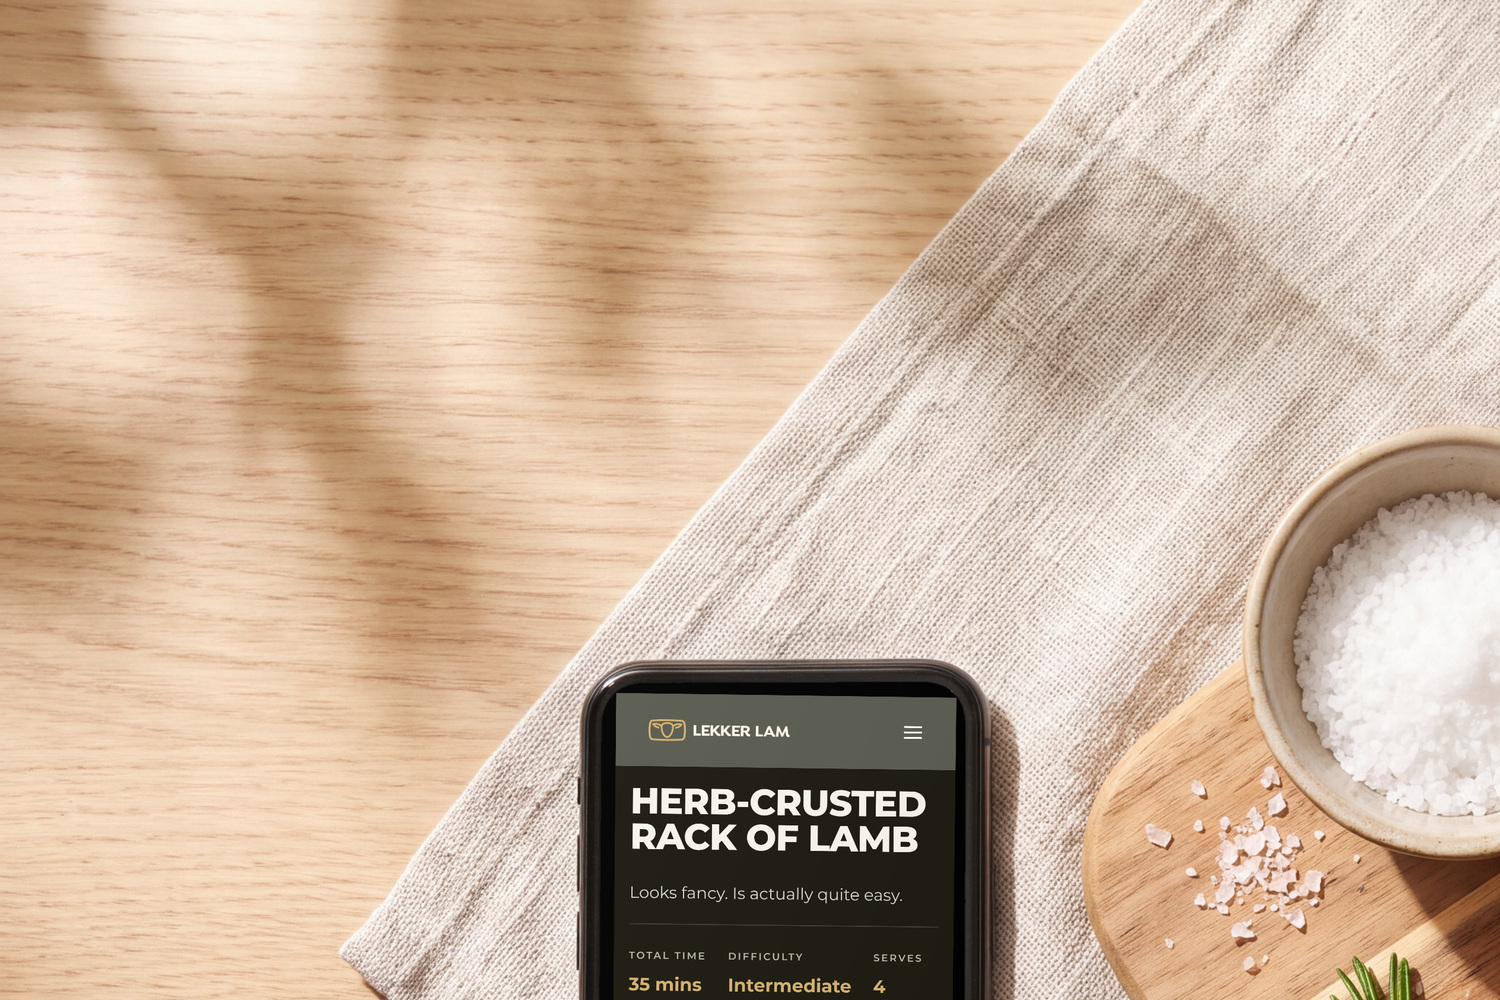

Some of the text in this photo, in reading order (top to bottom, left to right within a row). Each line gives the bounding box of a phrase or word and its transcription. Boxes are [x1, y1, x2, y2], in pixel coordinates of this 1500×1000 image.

[692, 724, 791, 738] LEKKER LAM
[632, 787, 927, 818] HERB-CRUSTED
[631, 822, 919, 853] RACK OF LAMB
[630, 885, 903, 905] Looks fancy. Is actually quite easy.
[628, 950, 705, 961] TOTAL TIME
[728, 952, 803, 961] DIFFICULTY
[873, 953, 922, 963] SERVES
[628, 976, 702, 992] 35 mins
[728, 977, 852, 994] Intermediate
[872, 979, 886, 994] 4
